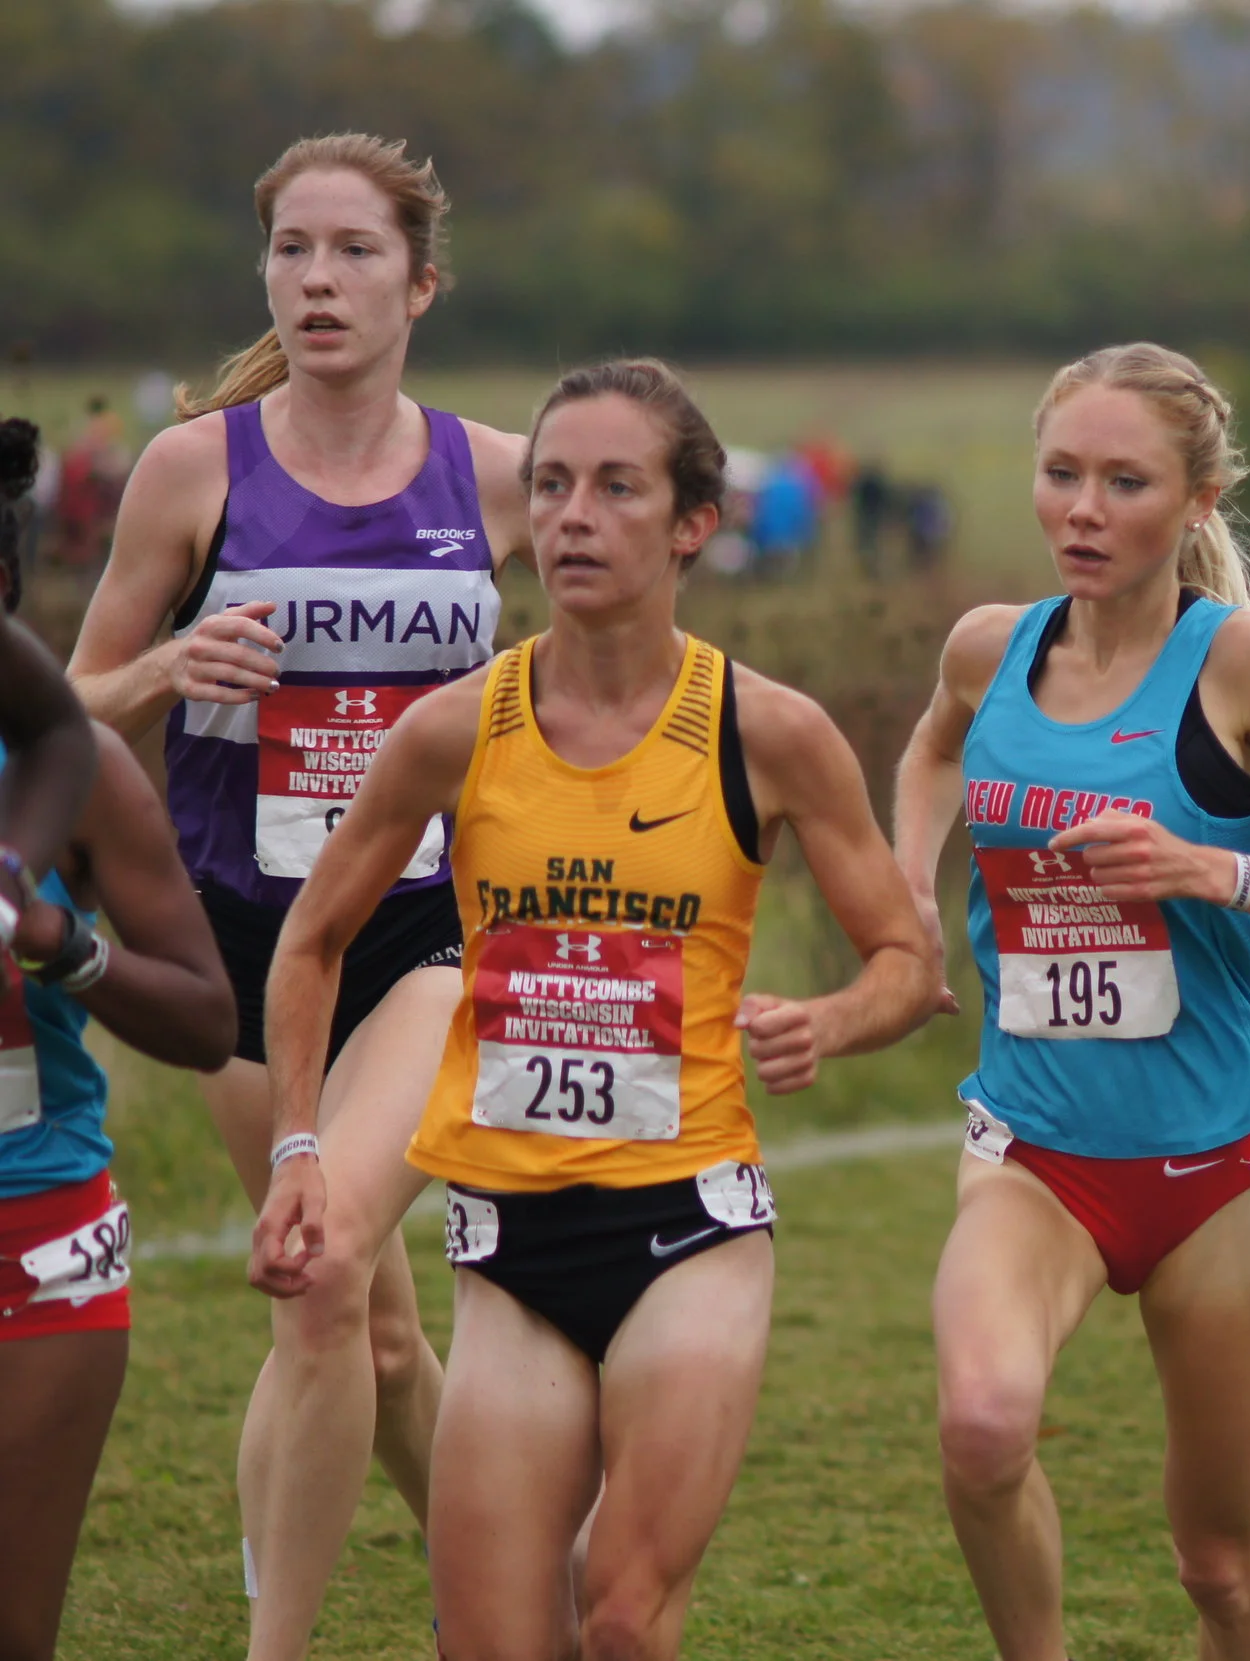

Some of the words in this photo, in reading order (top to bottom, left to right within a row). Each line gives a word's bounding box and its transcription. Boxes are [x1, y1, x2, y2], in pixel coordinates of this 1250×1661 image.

[415, 528, 477, 540] BROOKS
[226, 599, 481, 646] URMAN
[290, 727, 391, 750] NUTTYCO
[303, 750, 377, 772] WISCON
[967, 779, 1016, 826] NEW
[547, 856, 615, 883] SAN
[477, 879, 702, 932] FRANCISCO
[1006, 885, 1119, 904] NUTTYCOM
[1027, 903, 1123, 925] WISCONSIN
[1021, 924, 1147, 949] INVITATIONAL
[547, 961, 574, 970] UNDER
[575, 964, 609, 973] ARMOUR
[508, 970, 656, 1002] NUTTYCOMBE
[1046, 960, 1122, 1027] 195
[519, 996, 634, 1025] WISCONSIN
[504, 1016, 655, 1049] INVITATIONAL
[524, 1054, 616, 1126] 253
